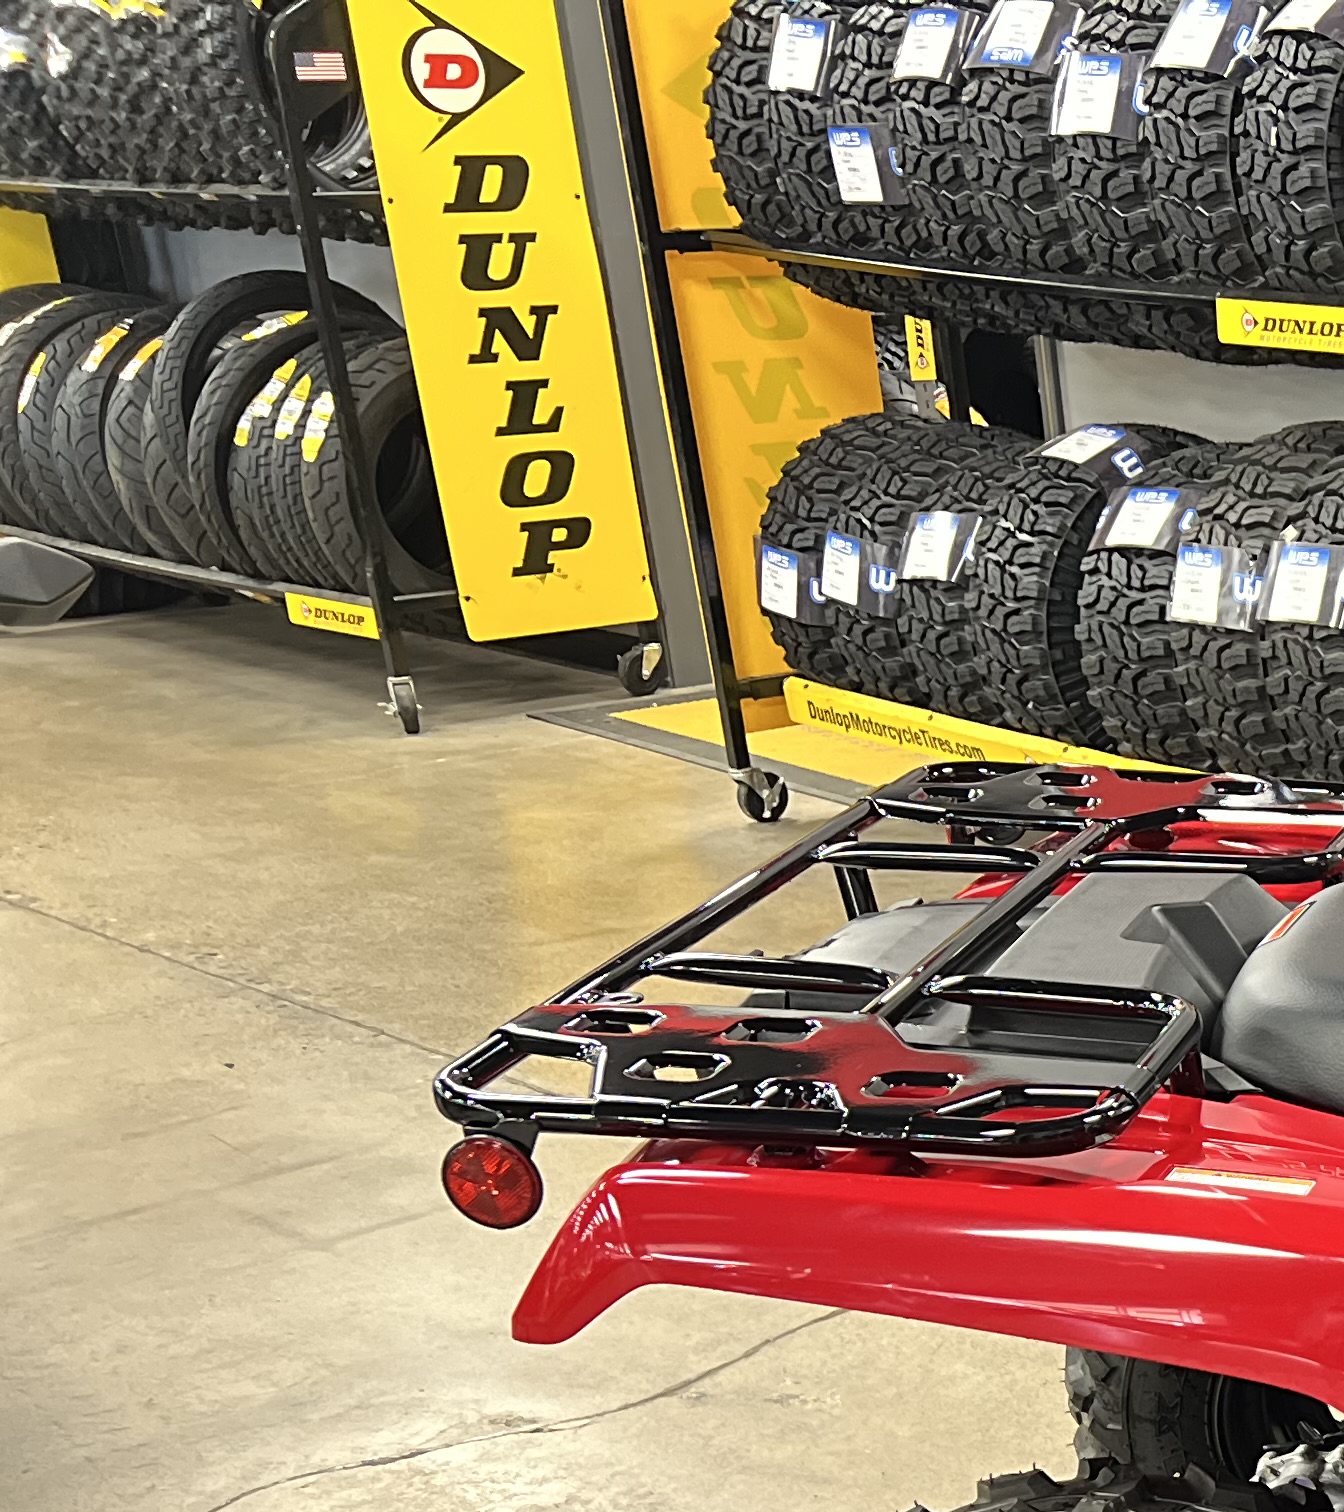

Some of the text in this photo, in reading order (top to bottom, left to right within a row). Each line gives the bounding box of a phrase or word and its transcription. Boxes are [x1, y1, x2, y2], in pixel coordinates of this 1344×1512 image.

[915, 13, 946, 26] WPS
[423, 53, 480, 89] D
[1077, 60, 1109, 75] WPS
[833, 131, 861, 147] WPS
[443, 154, 592, 579] DUNLOP
[1135, 491, 1168, 504] WPS
[1184, 551, 1213, 568] WPS
[1287, 550, 1319, 566] WPS
[314, 607, 365, 626] DUNLOP
[807, 700, 987, 761] DunlopMotorcycleTires.com
